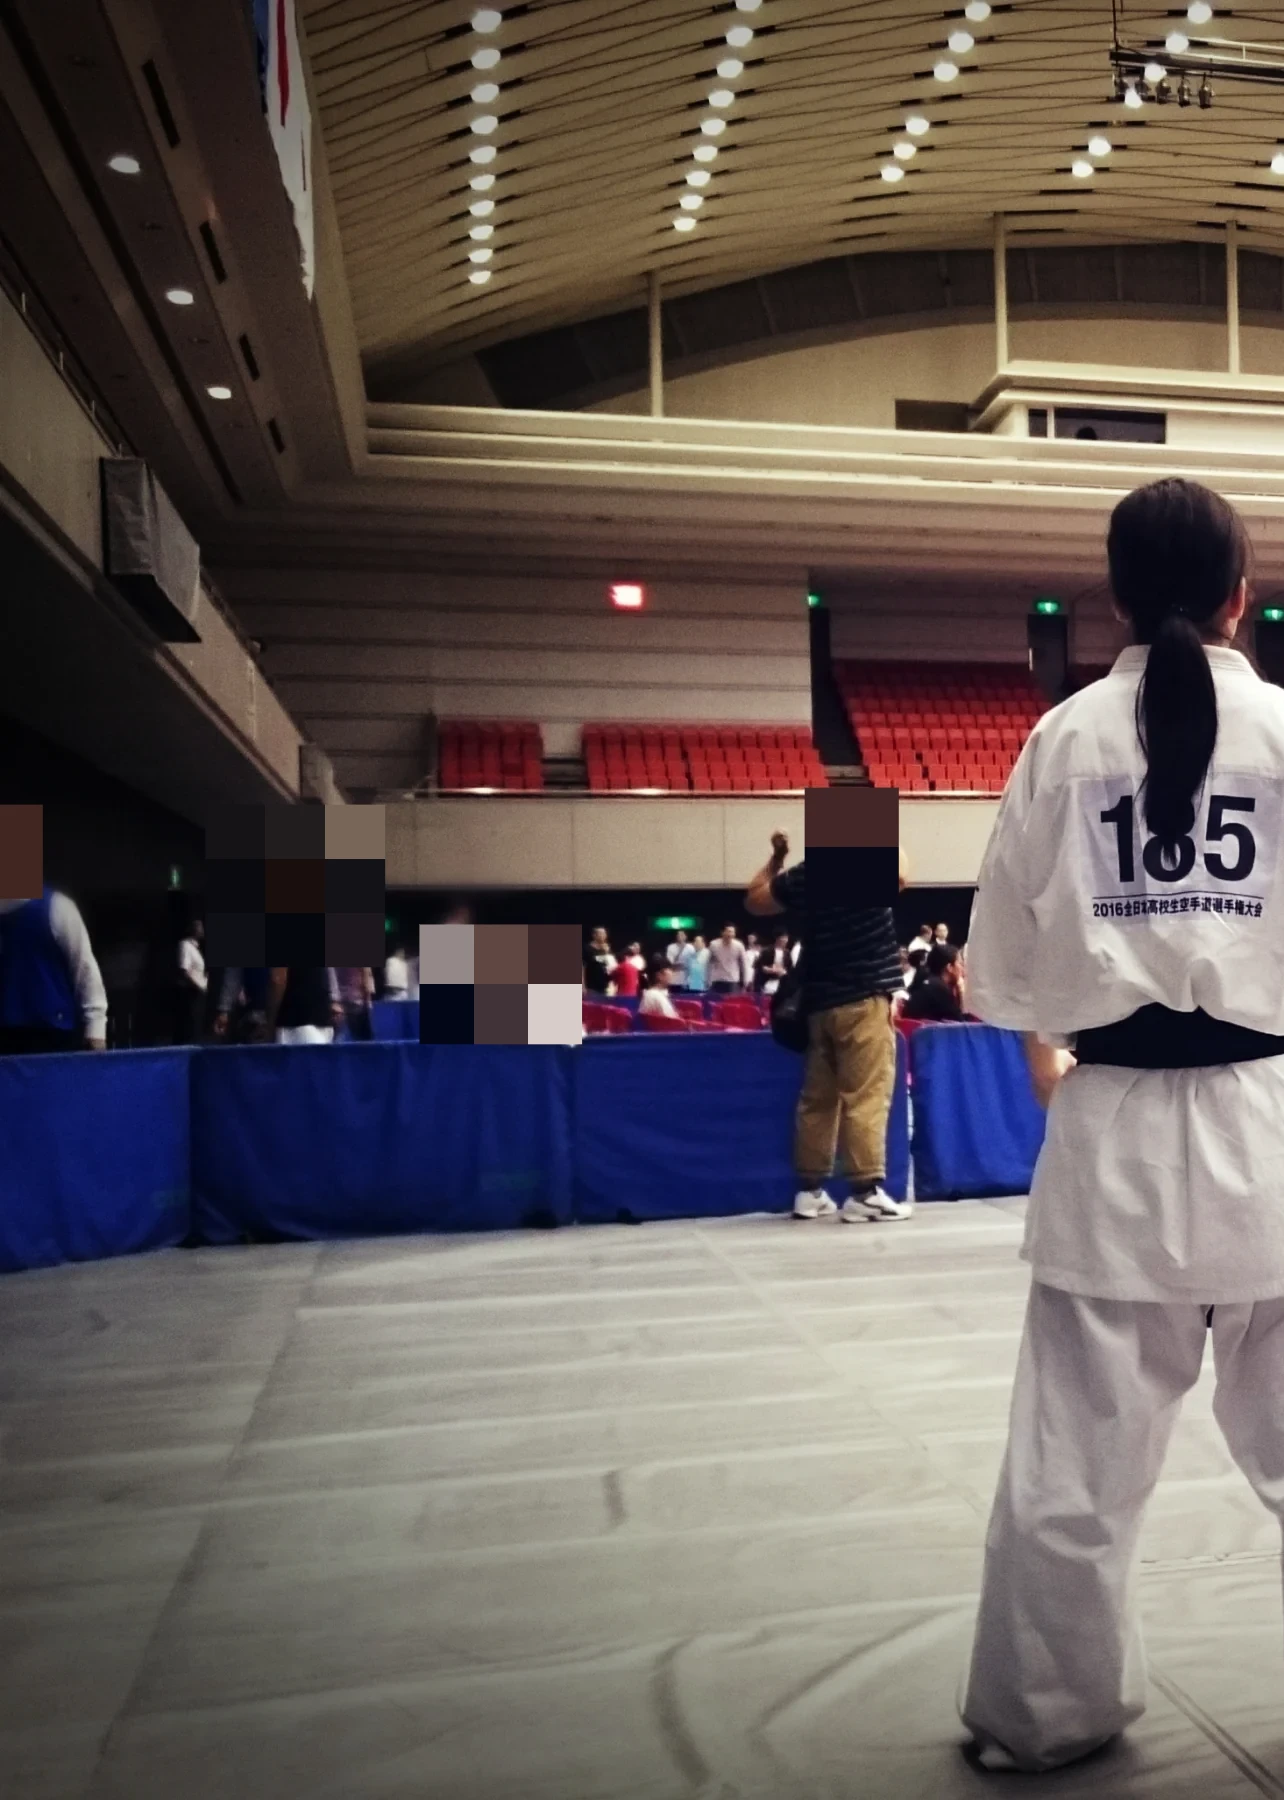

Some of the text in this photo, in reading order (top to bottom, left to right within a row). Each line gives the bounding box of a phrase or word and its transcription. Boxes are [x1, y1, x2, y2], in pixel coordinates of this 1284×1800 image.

[1092, 897, 1264, 917] 2016全日本高校生空手道選手権大会
